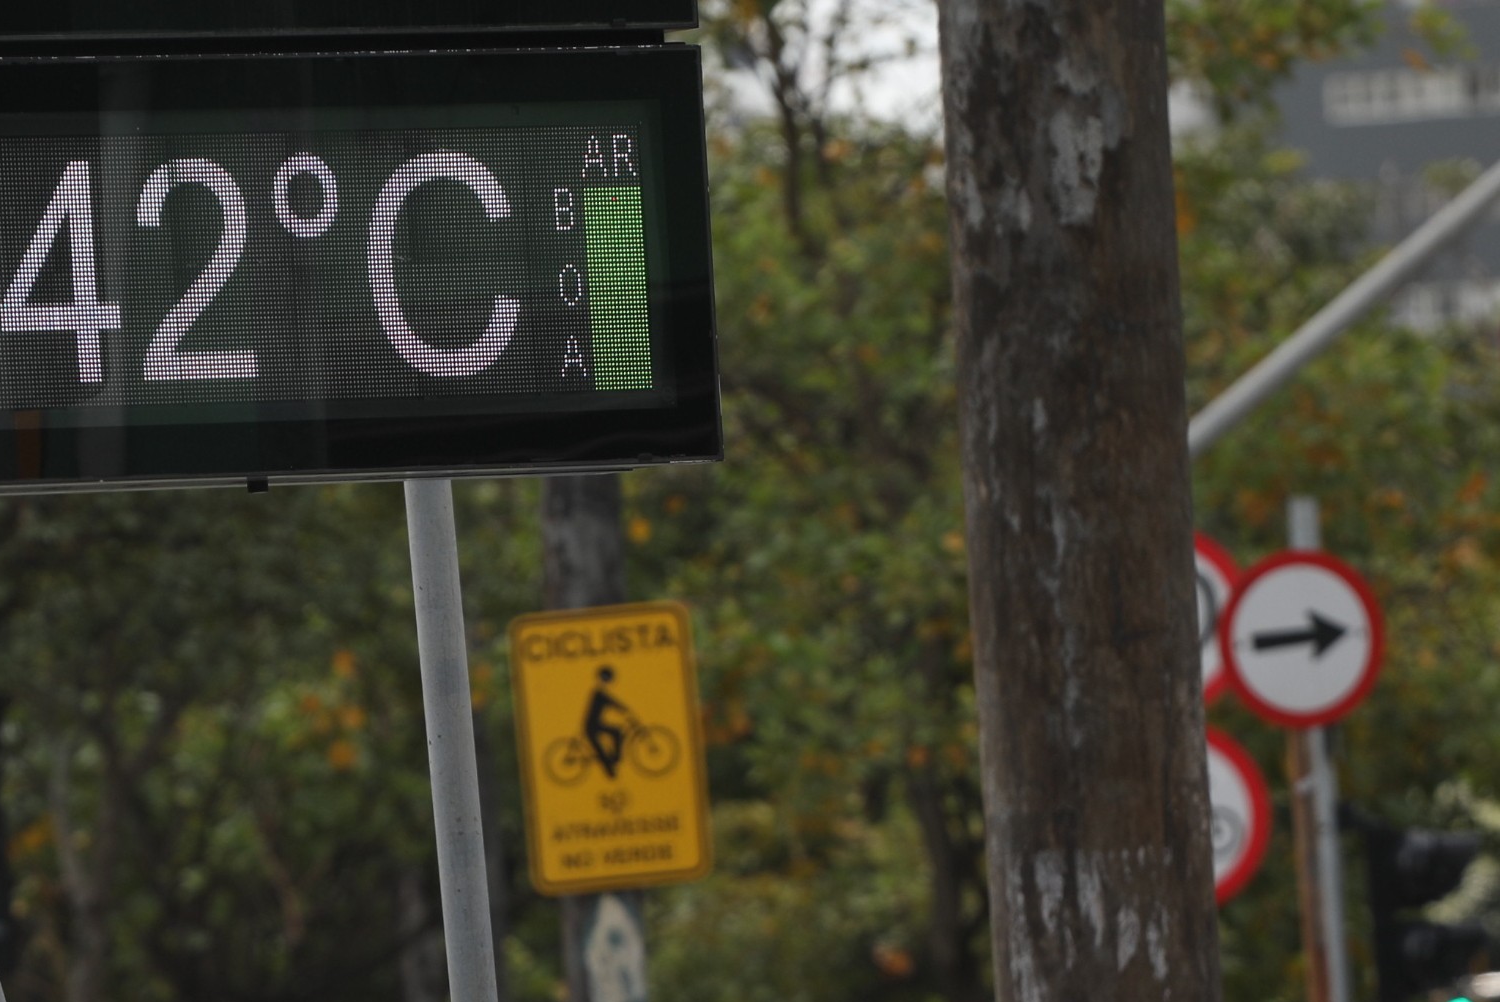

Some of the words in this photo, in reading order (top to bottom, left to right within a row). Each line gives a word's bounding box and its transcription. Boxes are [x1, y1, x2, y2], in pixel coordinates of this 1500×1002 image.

[581, 134, 638, 178] AR
[0, 148, 521, 382] 42°C
[520, 624, 674, 662] CICLISTA
